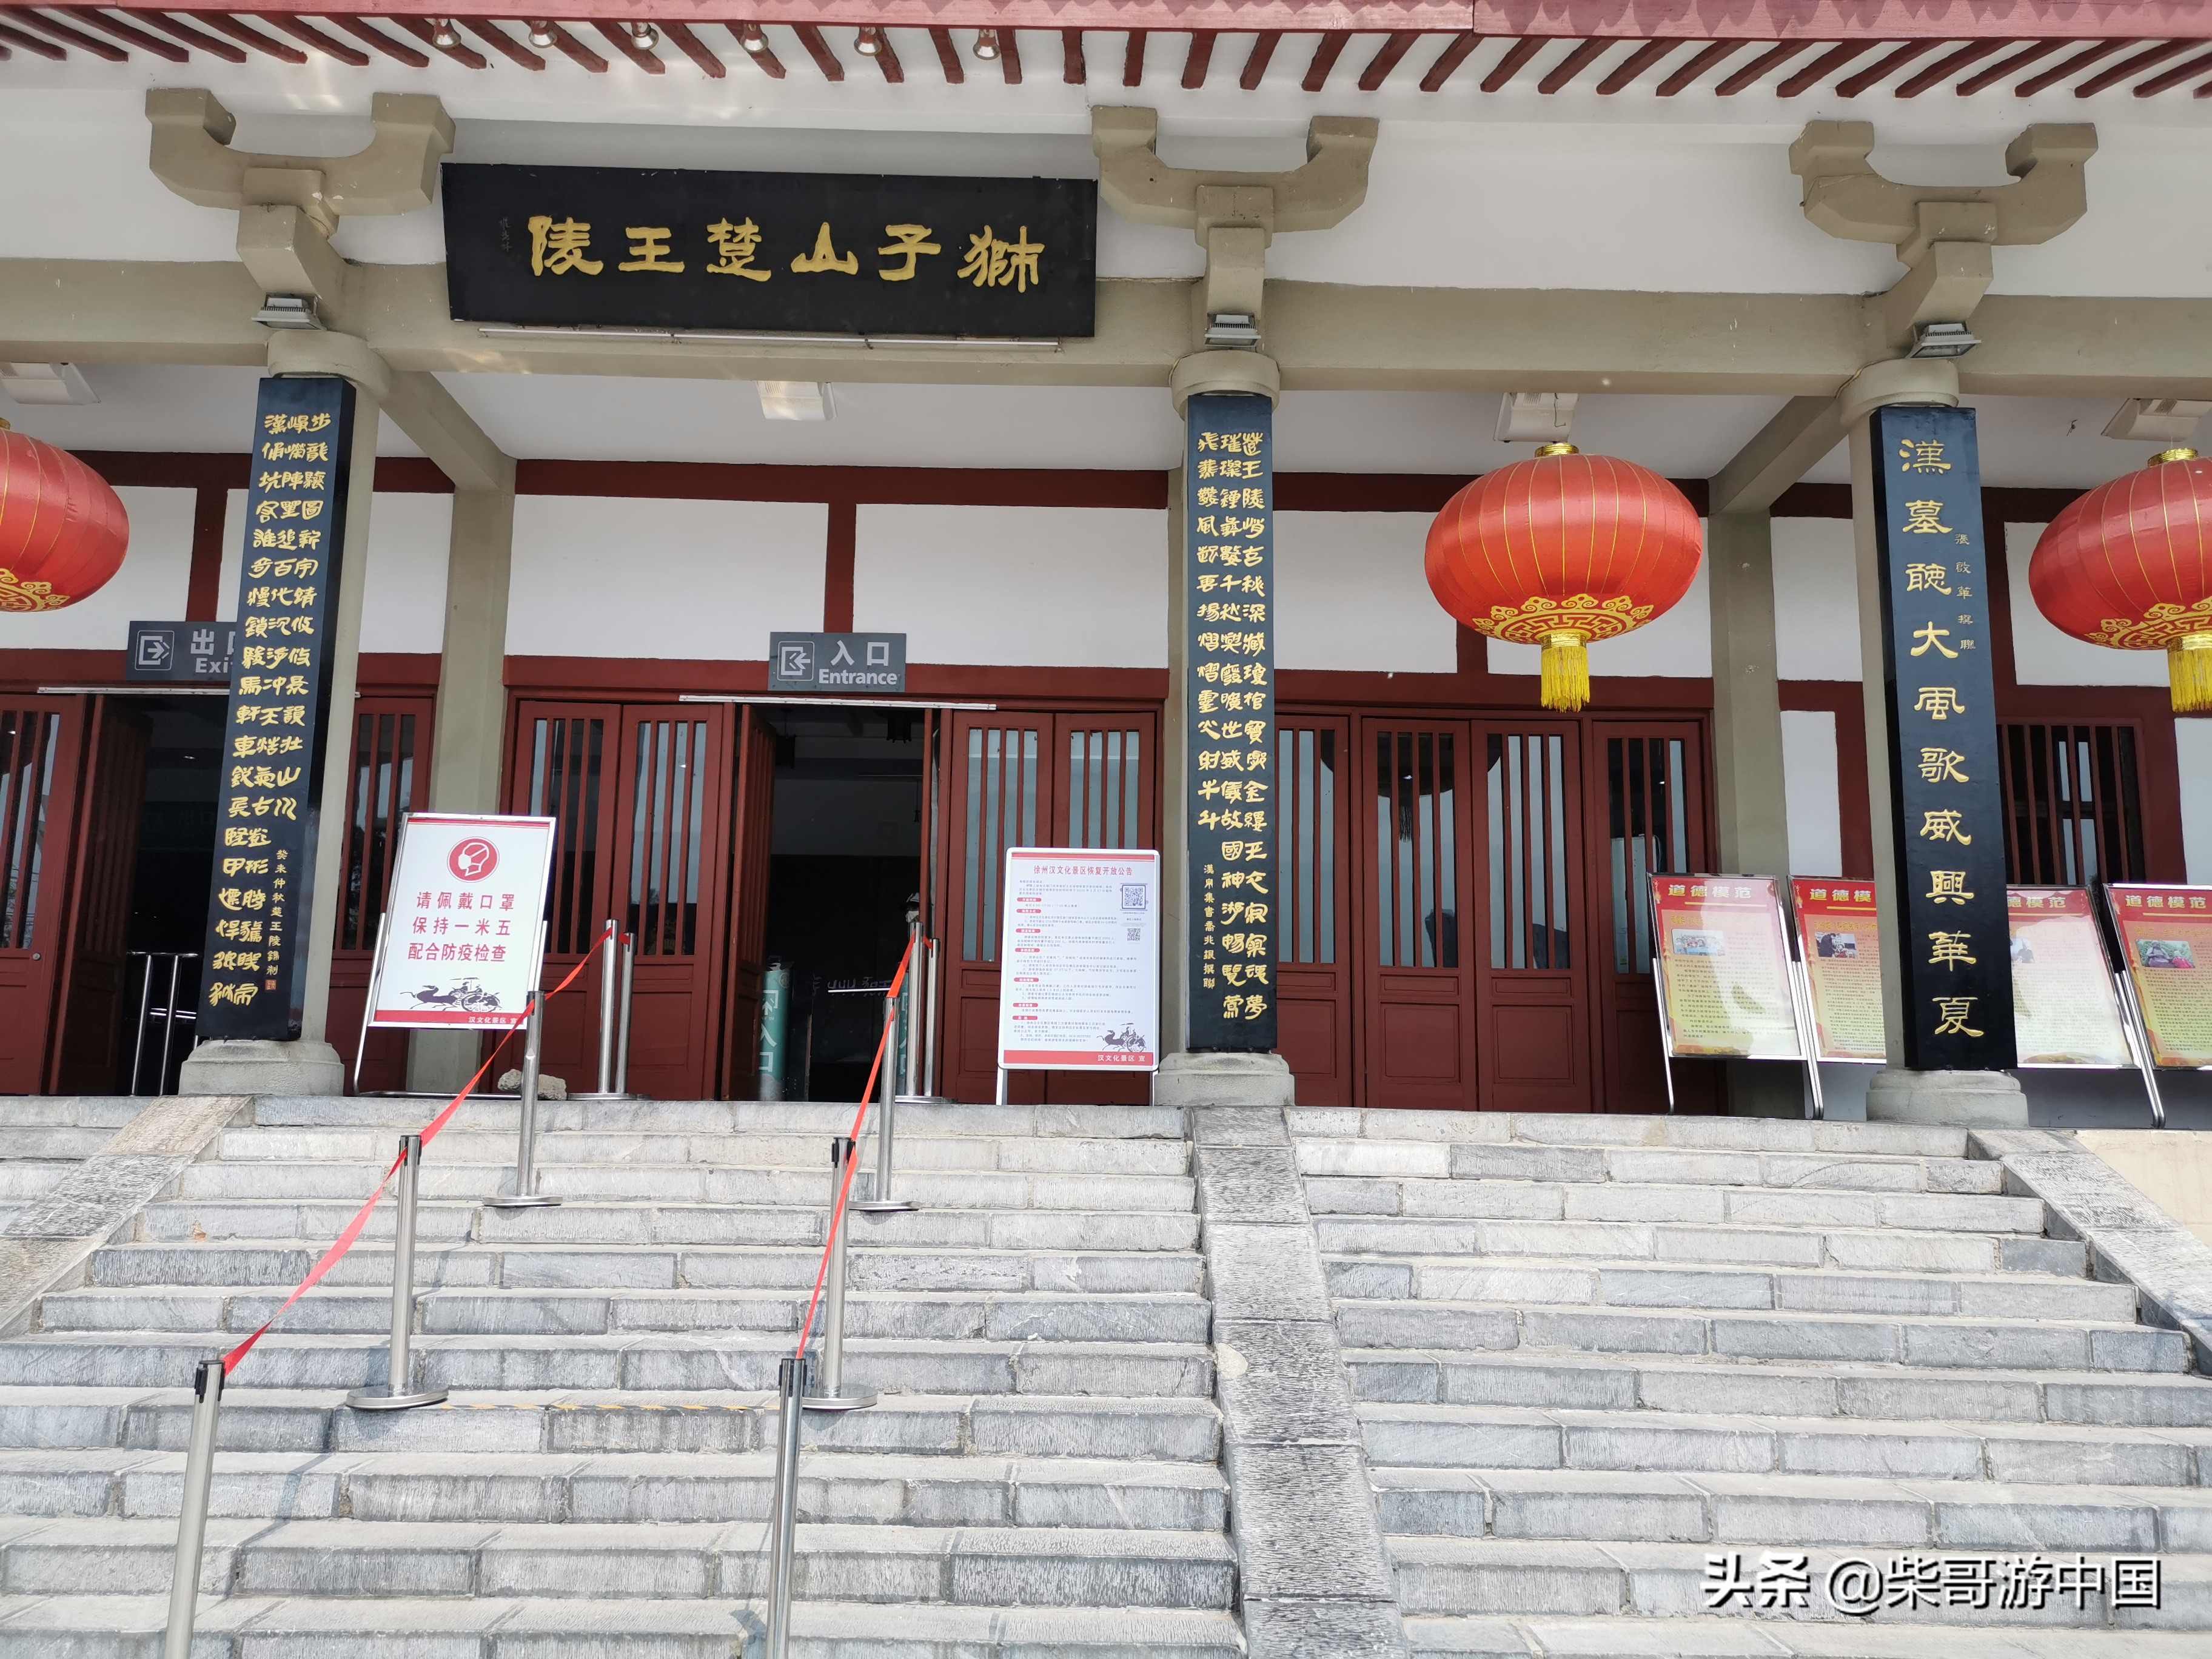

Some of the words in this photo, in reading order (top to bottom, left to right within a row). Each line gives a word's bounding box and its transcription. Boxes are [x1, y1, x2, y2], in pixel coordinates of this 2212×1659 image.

[830, 640, 889, 666] 入口
[195, 657, 233, 673] Exi
[819, 668, 897, 685] Entrance
[1033, 865, 1133, 876] 徐州汉文化景区恢复开放公告
[1668, 885, 1752, 899] 道德模范
[417, 891, 515, 911] 请佩戴口罩
[2126, 895, 2207, 909] 道德模范
[412, 916, 511, 936] 保持一米五
[407, 943, 506, 962] 配合防疫检查
